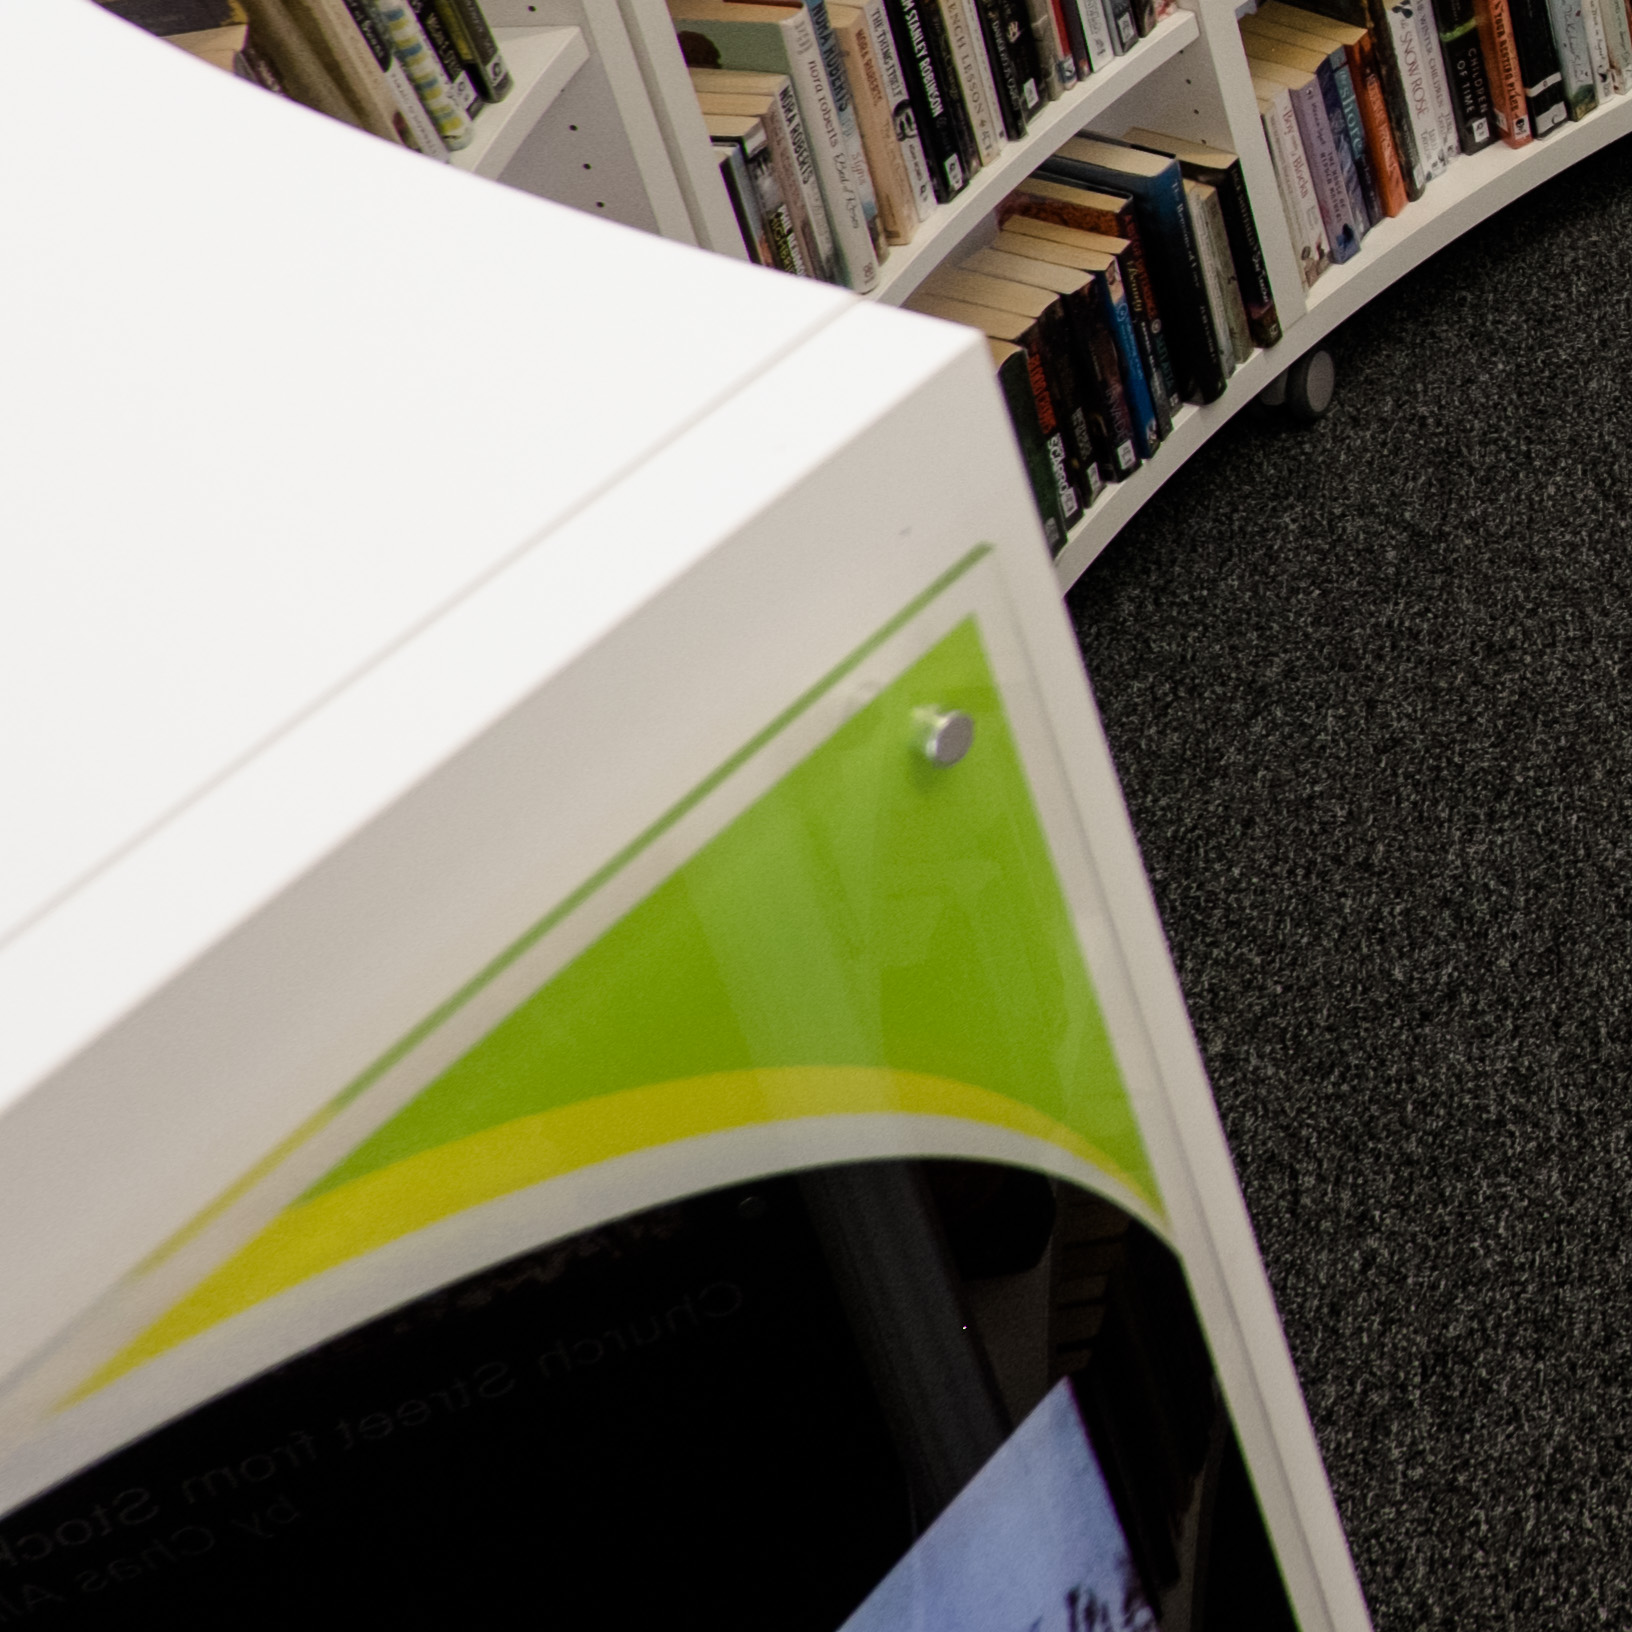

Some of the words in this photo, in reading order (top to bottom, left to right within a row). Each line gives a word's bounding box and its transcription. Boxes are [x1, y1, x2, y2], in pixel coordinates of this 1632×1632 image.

[808, 59, 824, 92] nora
[818, 93, 838, 148] roberts
[905, 11, 928, 56] STANLEY
[918, 56, 944, 119] ROBINSON
[959, 53, 985, 115] LESSON
[1467, 48, 1488, 114] CHILDREN
